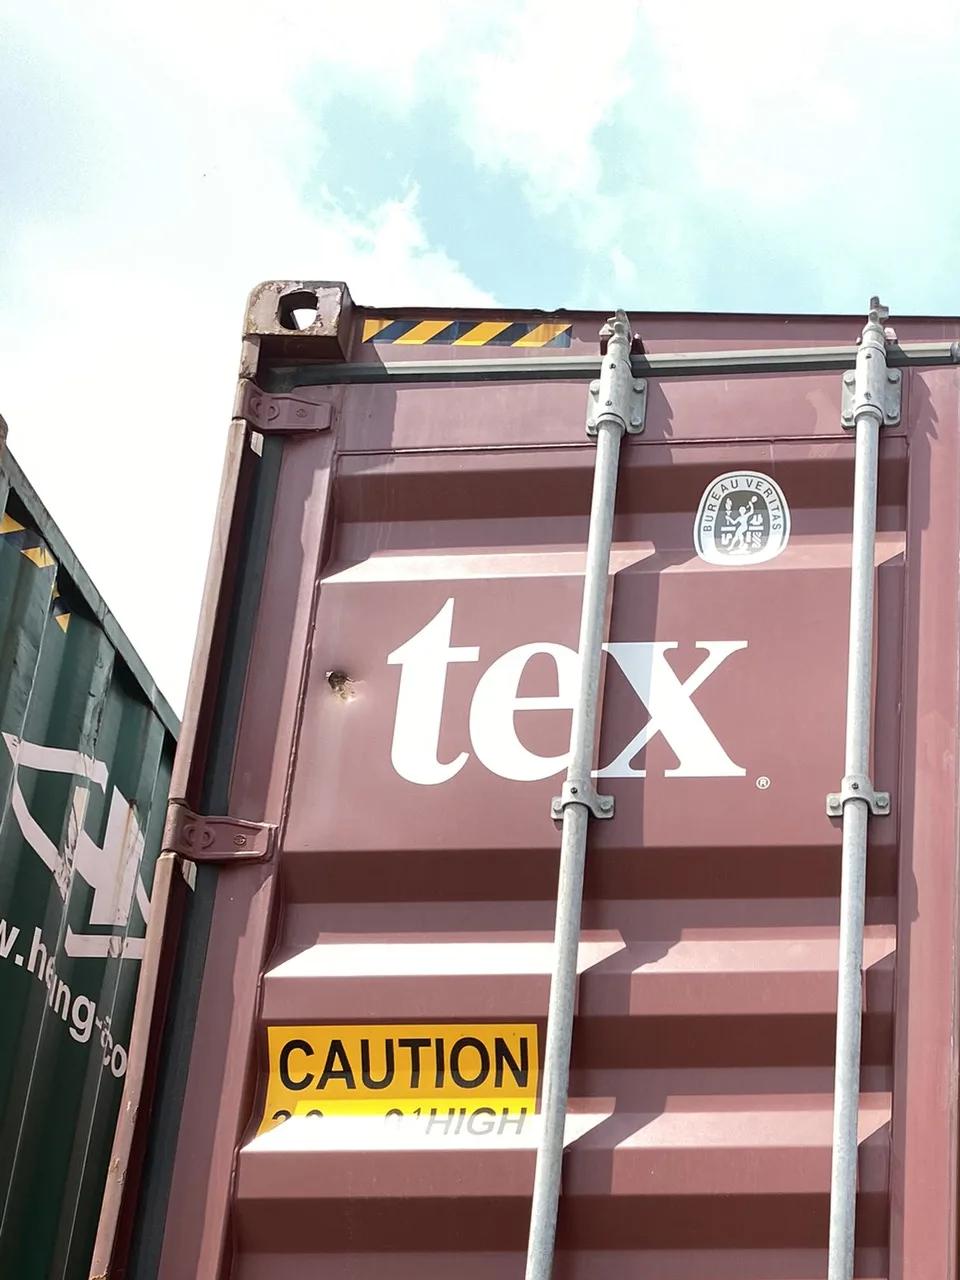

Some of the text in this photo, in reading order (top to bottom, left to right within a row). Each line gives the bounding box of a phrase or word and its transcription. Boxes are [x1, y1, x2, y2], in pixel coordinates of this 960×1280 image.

[703, 478, 782, 532] BUREAU VERITAS
[387, 598, 748, 785] tex
[279, 1037, 529, 1091] CAUTION
